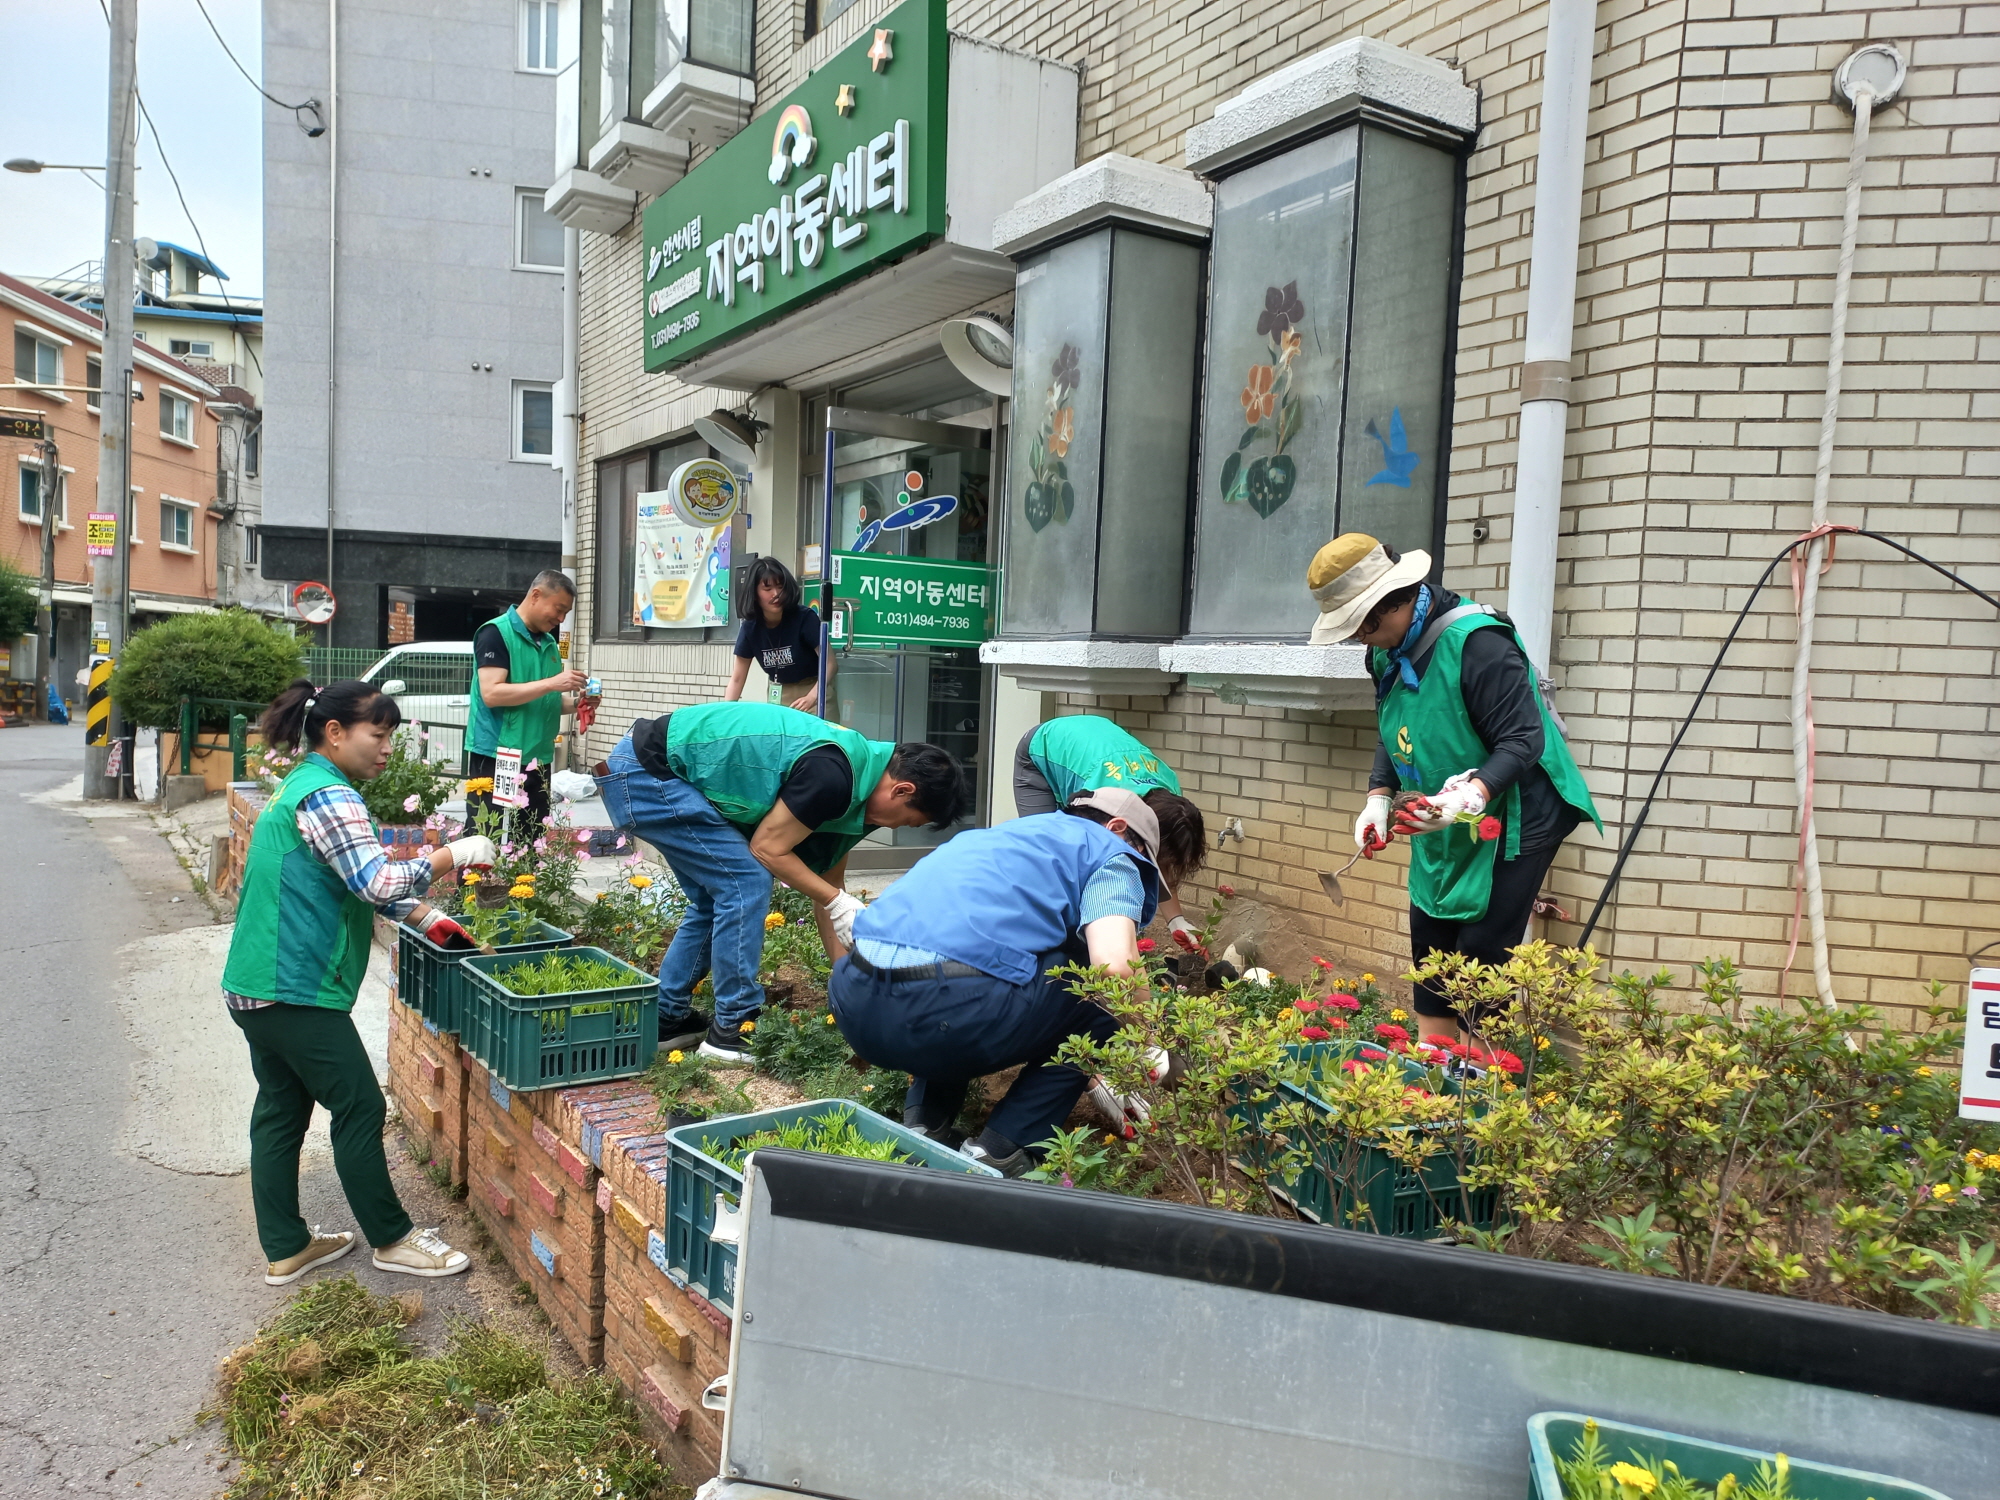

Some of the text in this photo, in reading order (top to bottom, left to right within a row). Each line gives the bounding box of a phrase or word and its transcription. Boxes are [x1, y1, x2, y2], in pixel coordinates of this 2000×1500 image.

[705, 118, 910, 307] 지역아동센터
[662, 214, 702, 269] 안산시립
[650, 310, 700, 350] T.031)494-7936
[859, 575, 986, 609] 지역아동센터
[874, 611, 970, 630] T.031)494-7936
